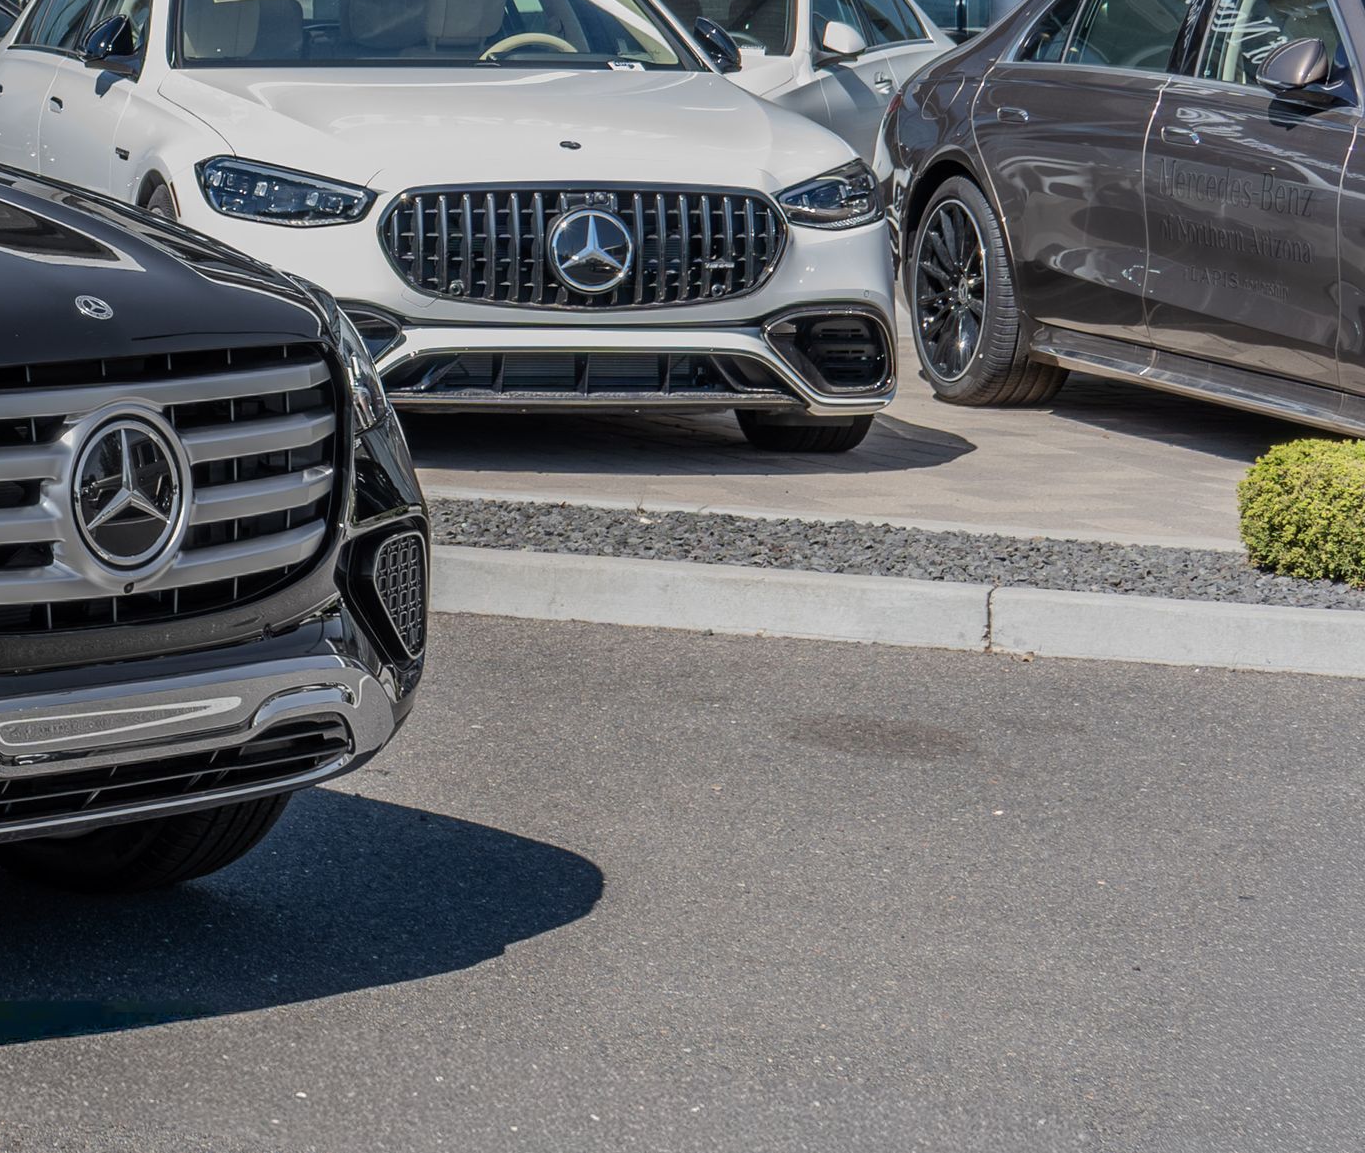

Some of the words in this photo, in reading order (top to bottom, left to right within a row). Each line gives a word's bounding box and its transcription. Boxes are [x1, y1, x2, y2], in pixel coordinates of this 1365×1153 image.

[1158, 158, 1315, 218] Mercedes-Benz
[1176, 215, 1246, 252] Northern
[1251, 225, 1314, 265] Arizona
